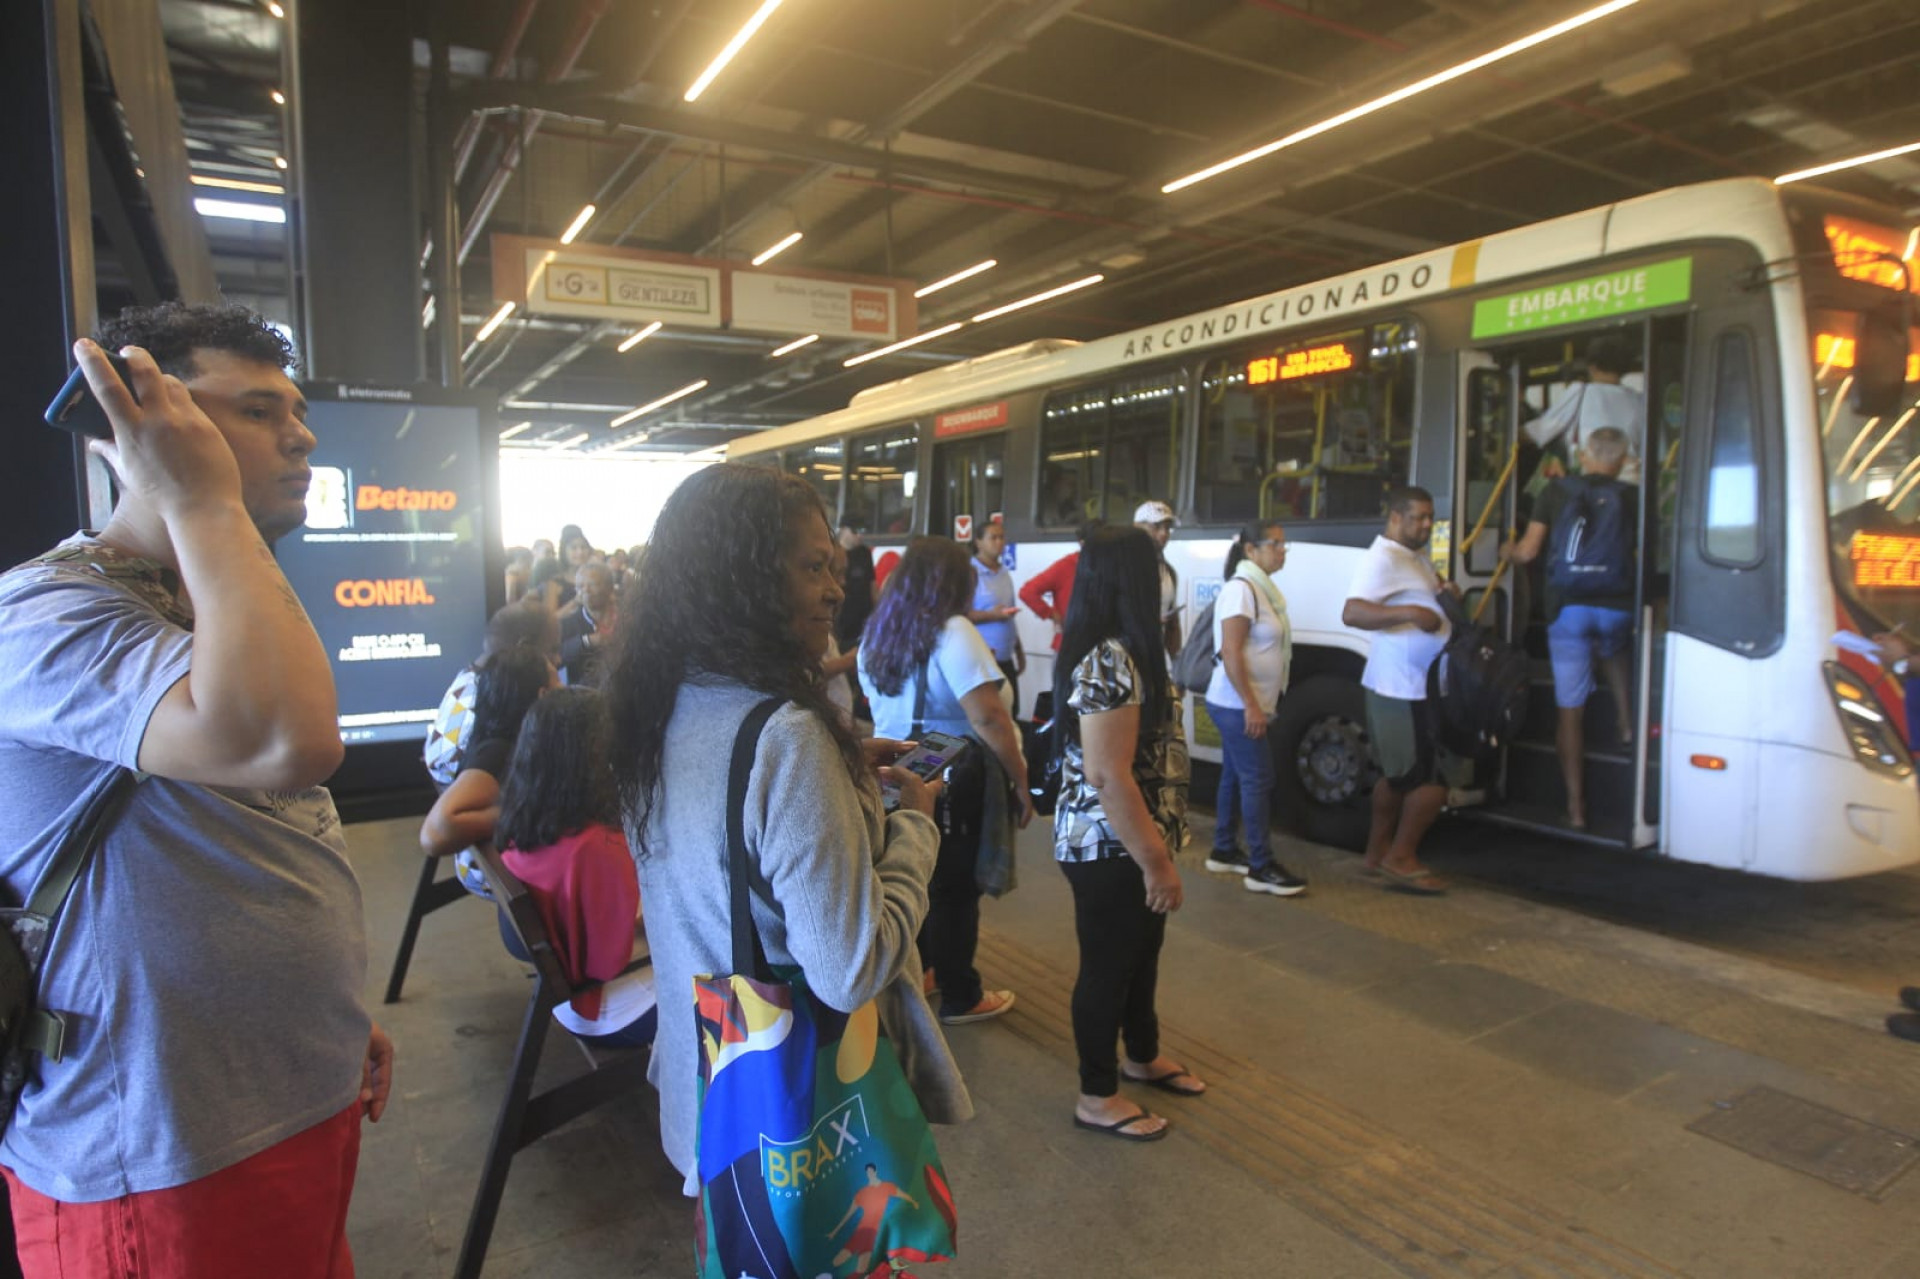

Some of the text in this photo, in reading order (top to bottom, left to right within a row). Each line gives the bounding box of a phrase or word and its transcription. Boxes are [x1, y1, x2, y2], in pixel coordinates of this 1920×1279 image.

[1507, 271, 1647, 317] EMBARQUE
[355, 485, 457, 511] Betano
[335, 577, 435, 608] CONFIA.
[768, 1109, 859, 1188] BRAX
